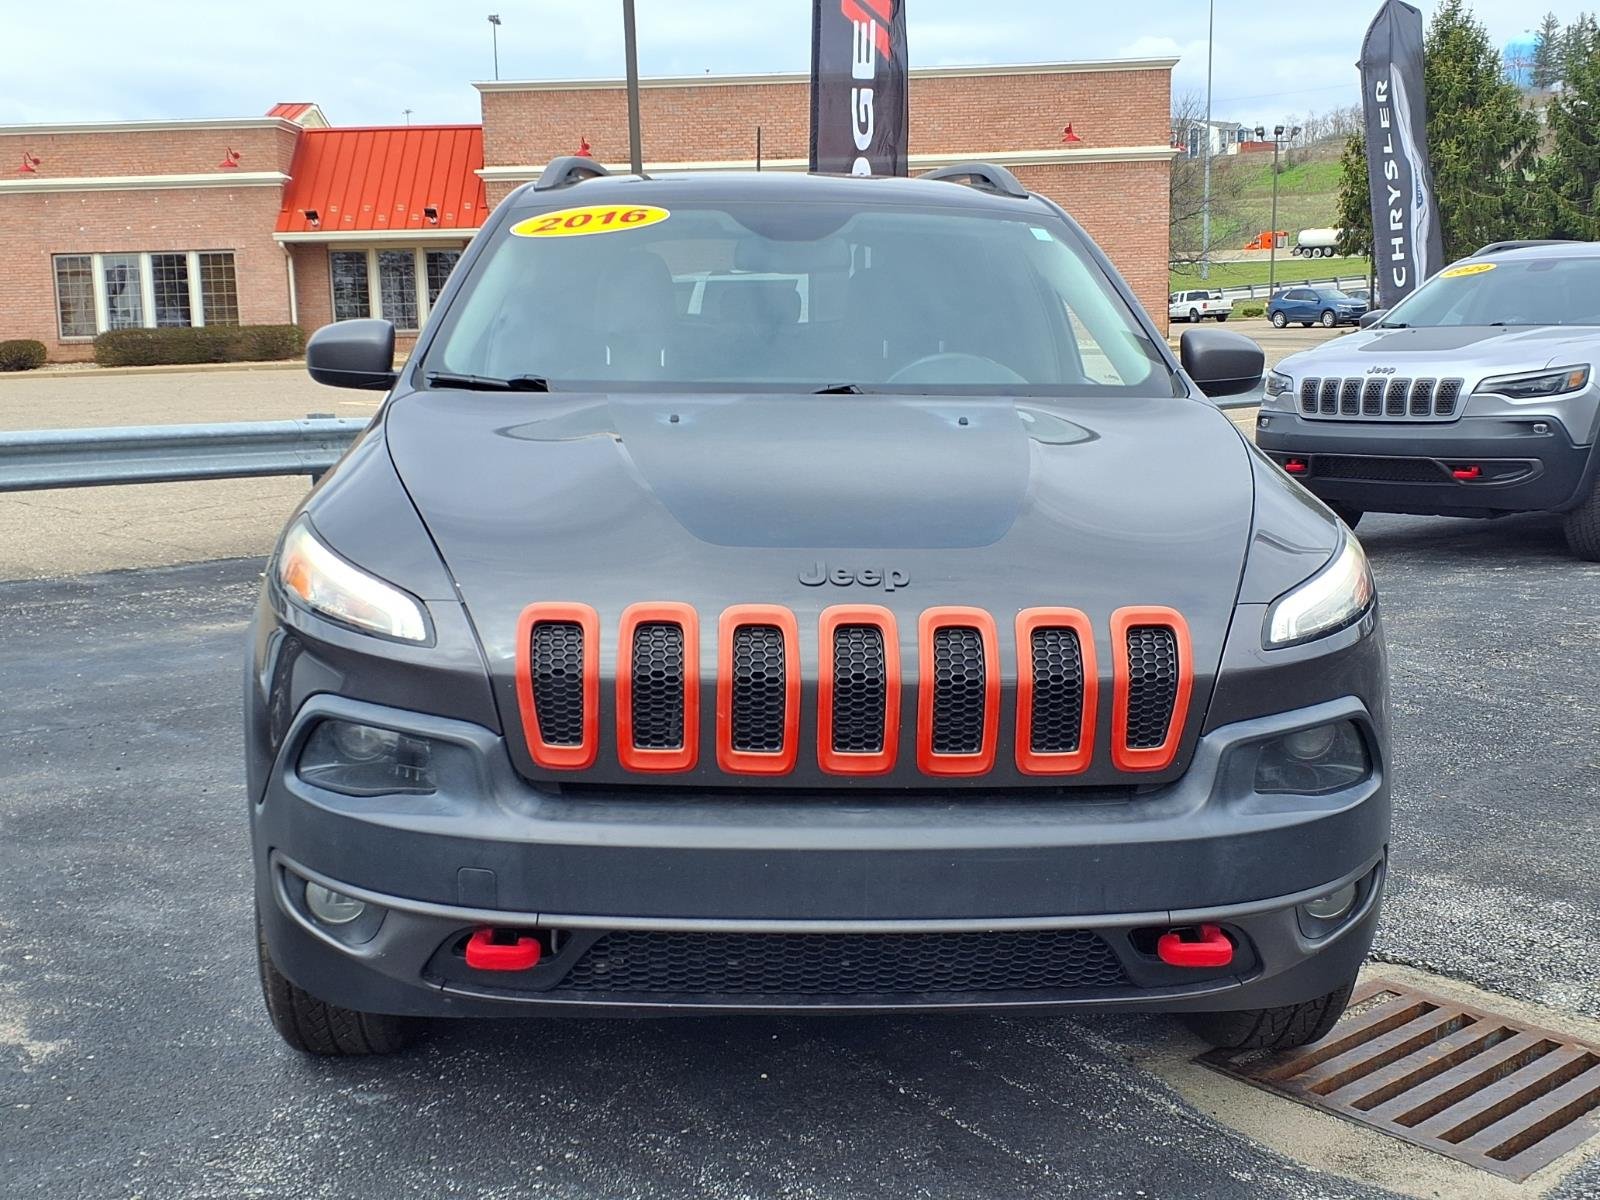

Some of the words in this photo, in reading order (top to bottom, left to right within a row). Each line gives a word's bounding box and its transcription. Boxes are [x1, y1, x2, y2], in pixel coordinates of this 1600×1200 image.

[1375, 80, 1406, 288] CHRYSLER
[532, 209, 648, 232] 2016
[1366, 366, 1396, 375] Jeep
[798, 559, 911, 592] Jeep
